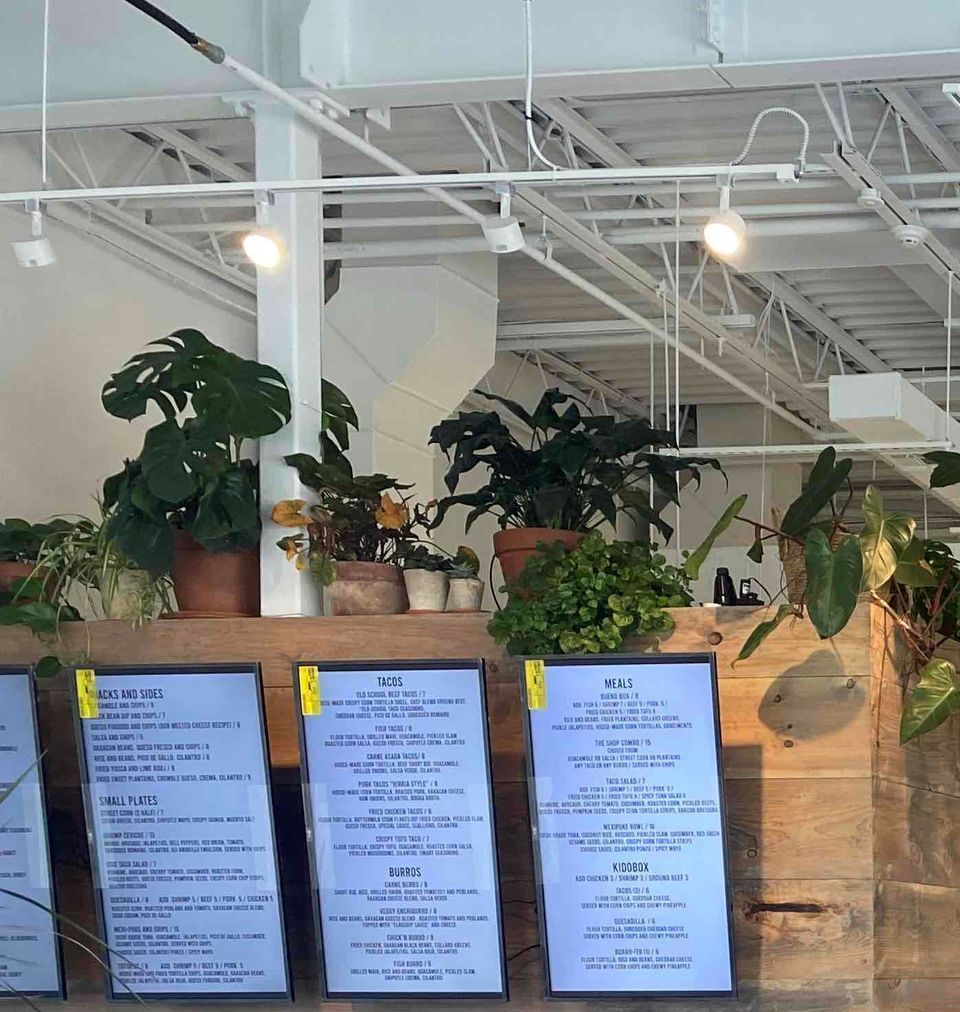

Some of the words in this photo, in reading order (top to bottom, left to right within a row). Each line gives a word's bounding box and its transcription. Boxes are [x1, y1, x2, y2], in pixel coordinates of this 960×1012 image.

[376, 676, 403, 687] TACOS
[604, 678, 633, 689] MEALS
[122, 689, 138, 699] AND
[140, 688, 164, 698] SIDES
[98, 796, 127, 806] SMALL
[128, 796, 158, 806] PLATES
[388, 867, 422, 878] BURROS
